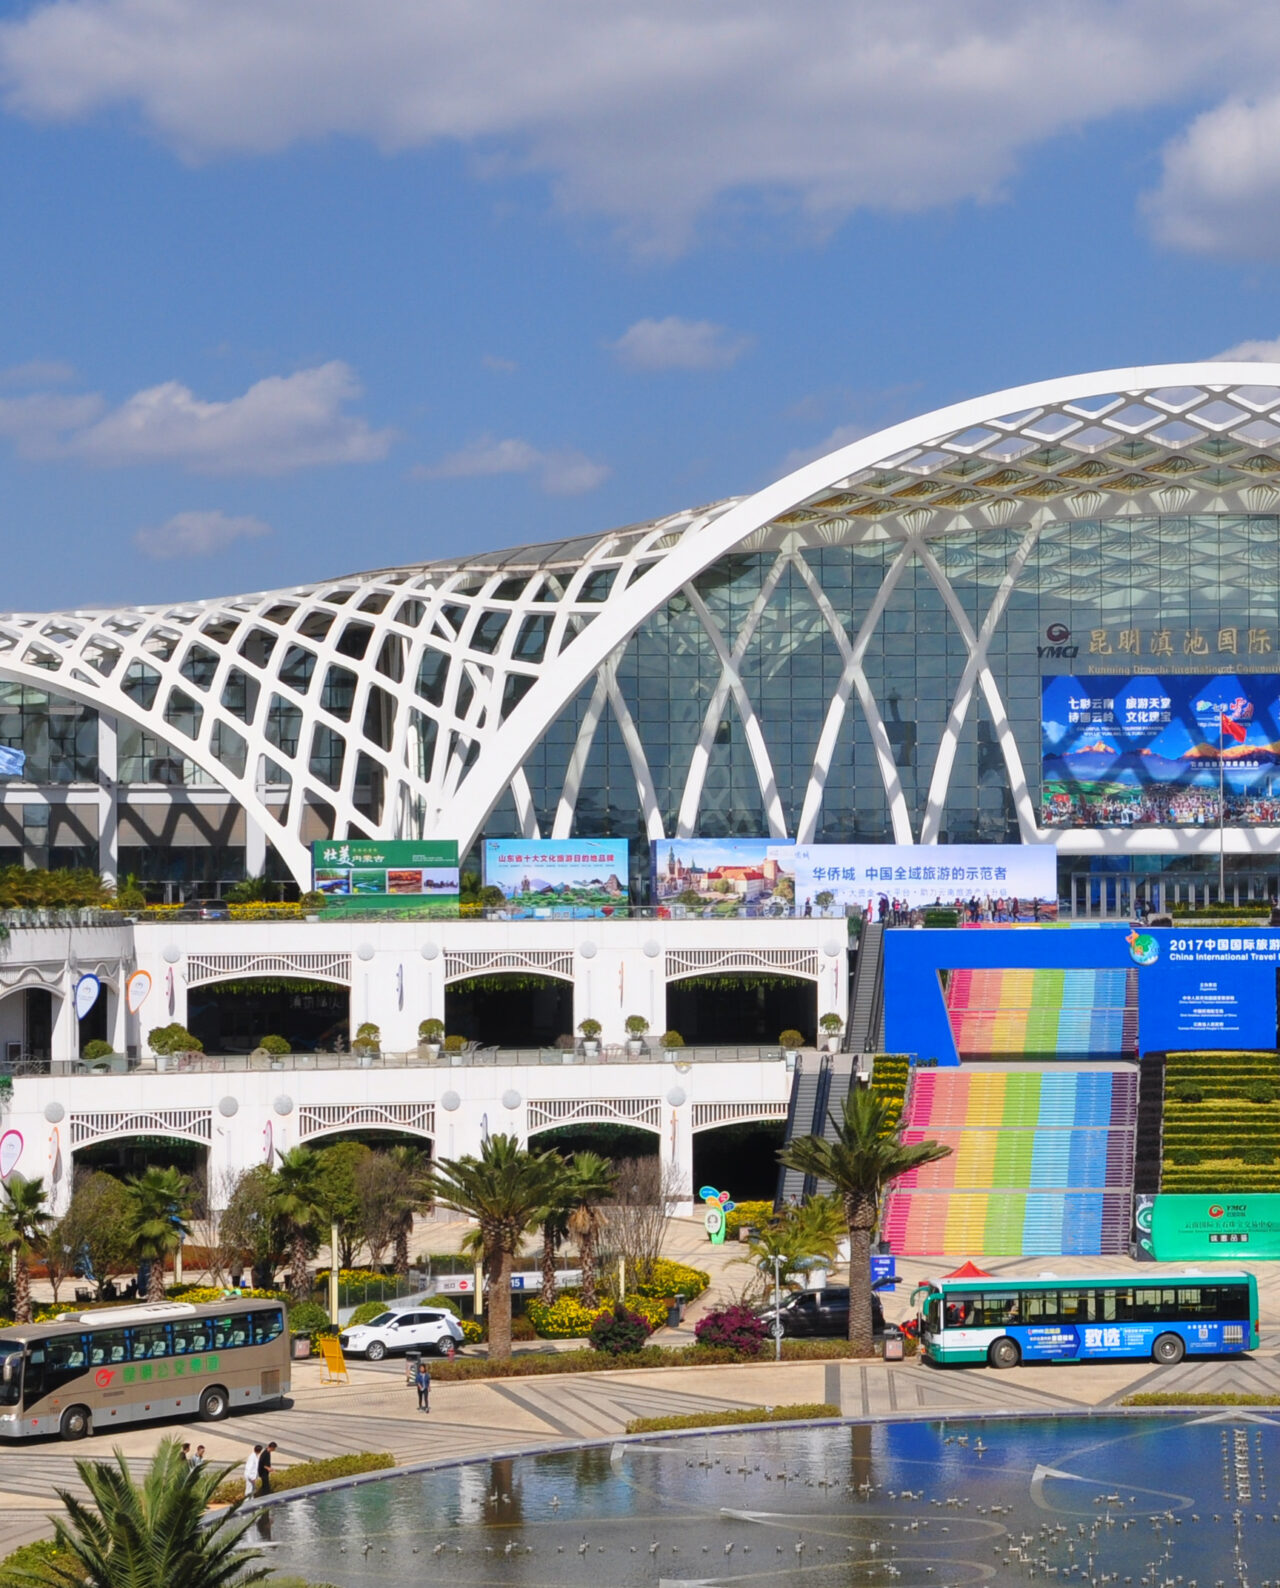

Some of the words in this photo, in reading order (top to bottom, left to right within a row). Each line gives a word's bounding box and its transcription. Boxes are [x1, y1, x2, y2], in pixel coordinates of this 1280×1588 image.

[812, 866, 856, 881] 华侨城
[865, 866, 1007, 881] 中国全域旅游的示范者
[1169, 953, 1194, 961] China
[1196, 952, 1249, 961] International
[1250, 952, 1276, 961] Travel
